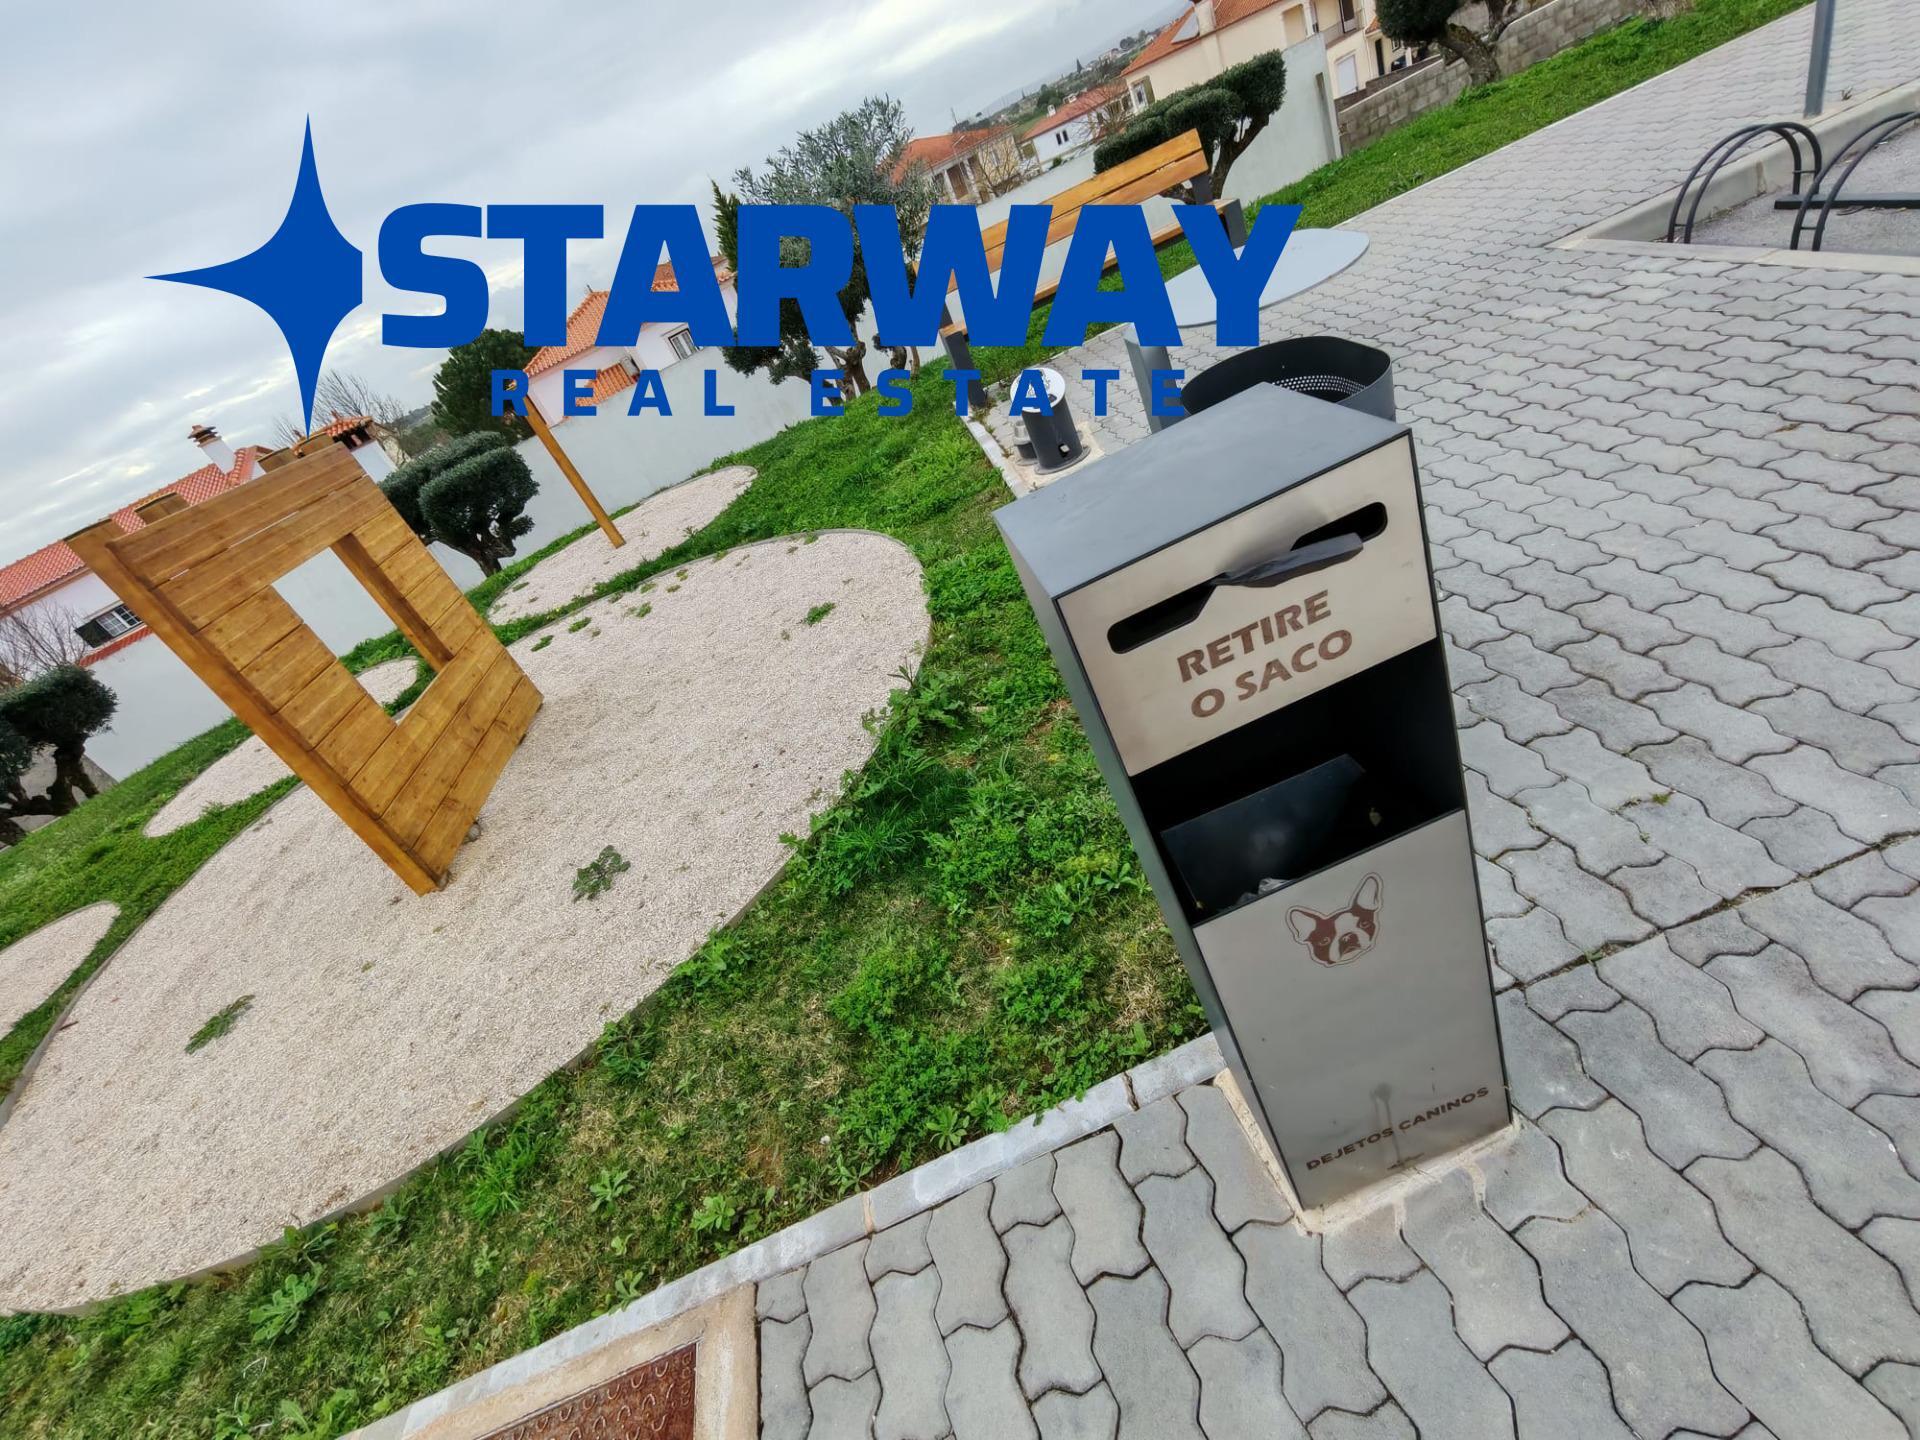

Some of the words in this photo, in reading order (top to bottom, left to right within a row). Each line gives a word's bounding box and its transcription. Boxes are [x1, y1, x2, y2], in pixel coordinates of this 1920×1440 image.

[1177, 589, 1332, 683] RETIRE
[1191, 688, 1225, 718] O
[1235, 629, 1353, 701] SACO
[1306, 1127, 1394, 1170] DEJETOS
[1398, 1087, 1489, 1131] CANINOS
